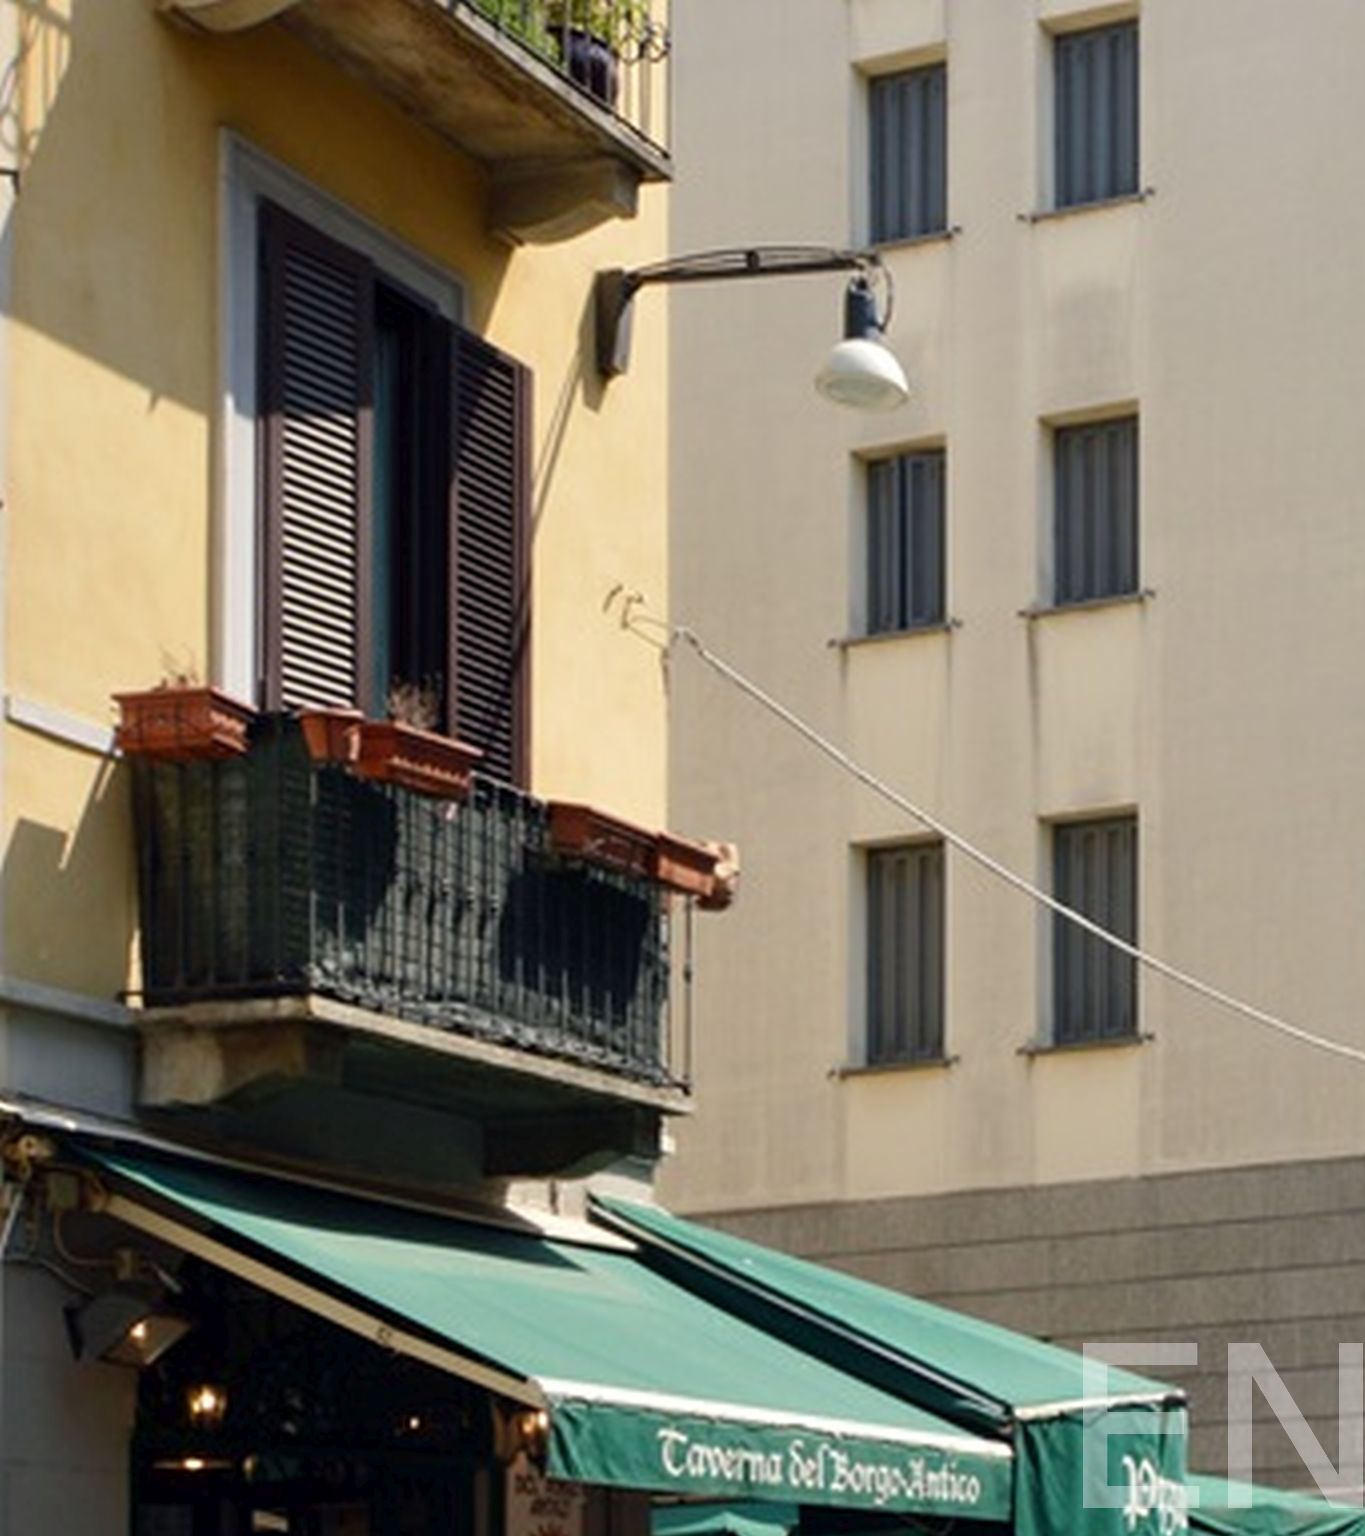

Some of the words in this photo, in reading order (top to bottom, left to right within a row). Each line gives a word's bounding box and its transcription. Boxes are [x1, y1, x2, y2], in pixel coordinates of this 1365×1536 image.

[656, 1428, 783, 1485] Taverna
[788, 1438, 828, 1489] del
[830, 1448, 903, 1505] Borgo
[903, 1457, 981, 1505] Antico
